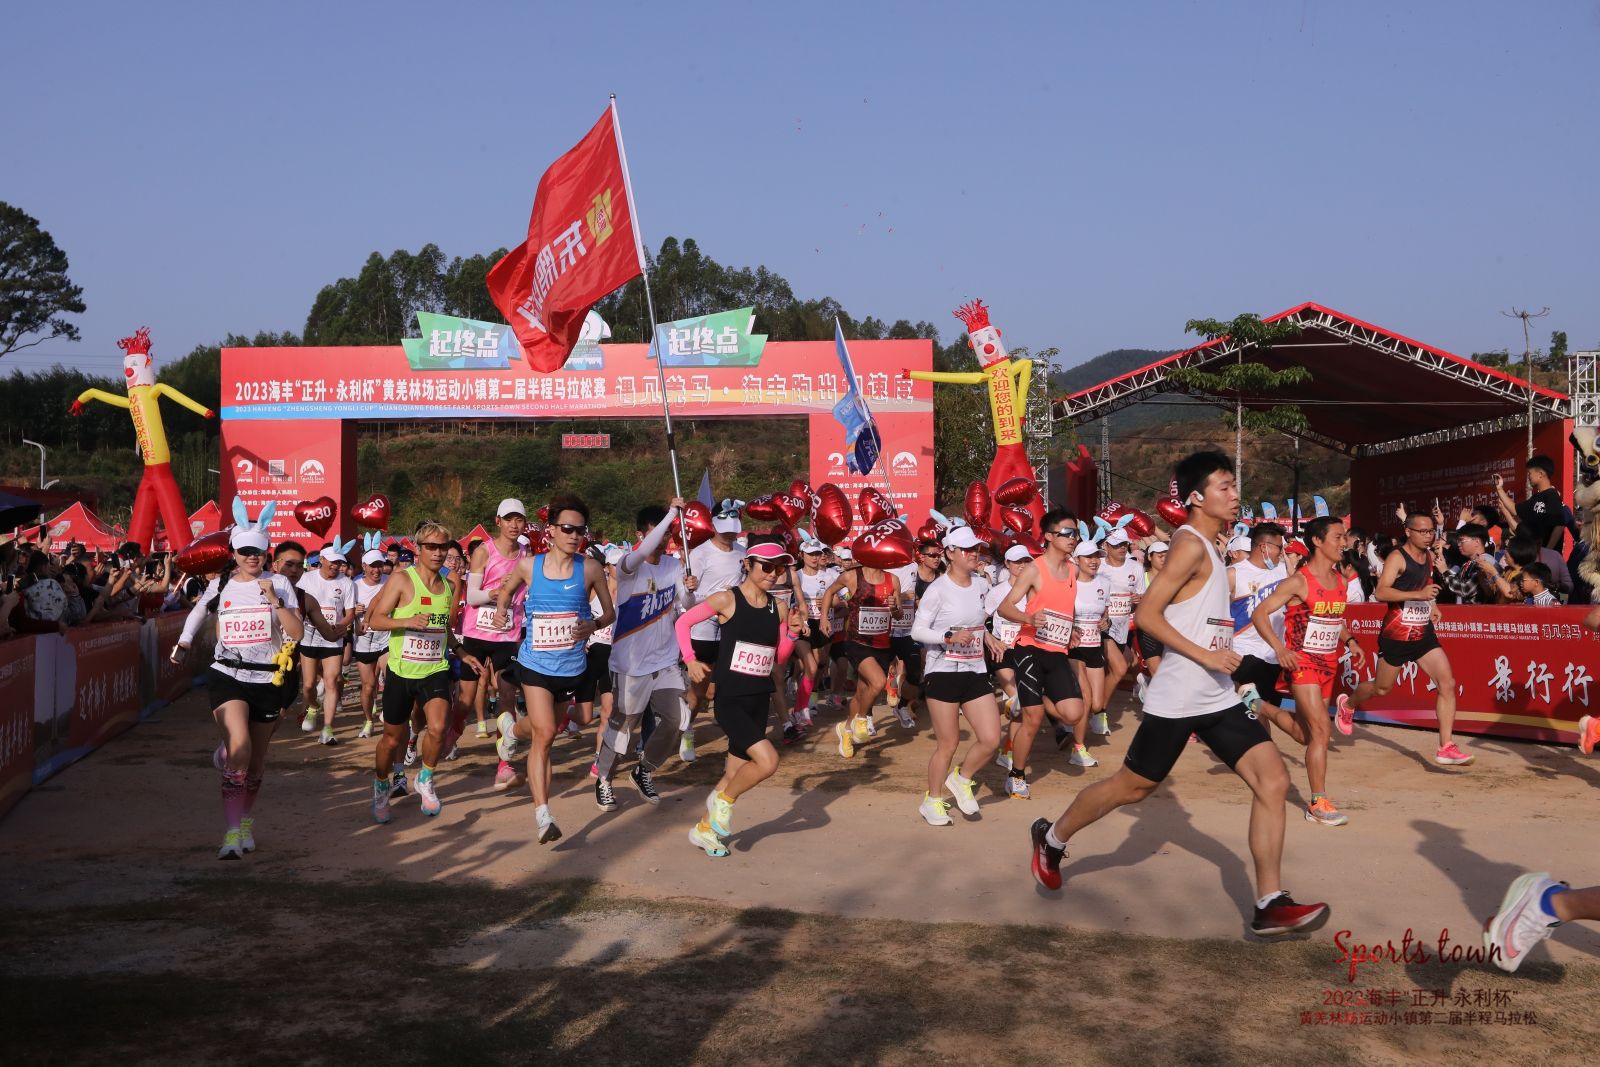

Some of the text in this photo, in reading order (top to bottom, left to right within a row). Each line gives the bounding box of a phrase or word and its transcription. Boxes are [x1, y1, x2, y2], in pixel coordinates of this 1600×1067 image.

[429, 329, 499, 358] 起终点
[668, 326, 739, 356] 起终点
[569, 402, 607, 410] MARATHON
[992, 367, 1017, 441] 欢迎您的到来
[358, 498, 385, 519] 2:30
[782, 495, 805, 510] 2:00
[871, 492, 893, 516] 2:00
[1100, 502, 1121, 520] 3:00
[303, 505, 331, 522] 2:30
[864, 520, 902, 549] 2:30
[225, 619, 265, 633] F0282
[862, 616, 888, 625] A0764
[1041, 621, 1071, 637] A0772
[538, 624, 573, 637] T1111
[408, 638, 441, 651] T8888
[738, 650, 773, 667] F0304
